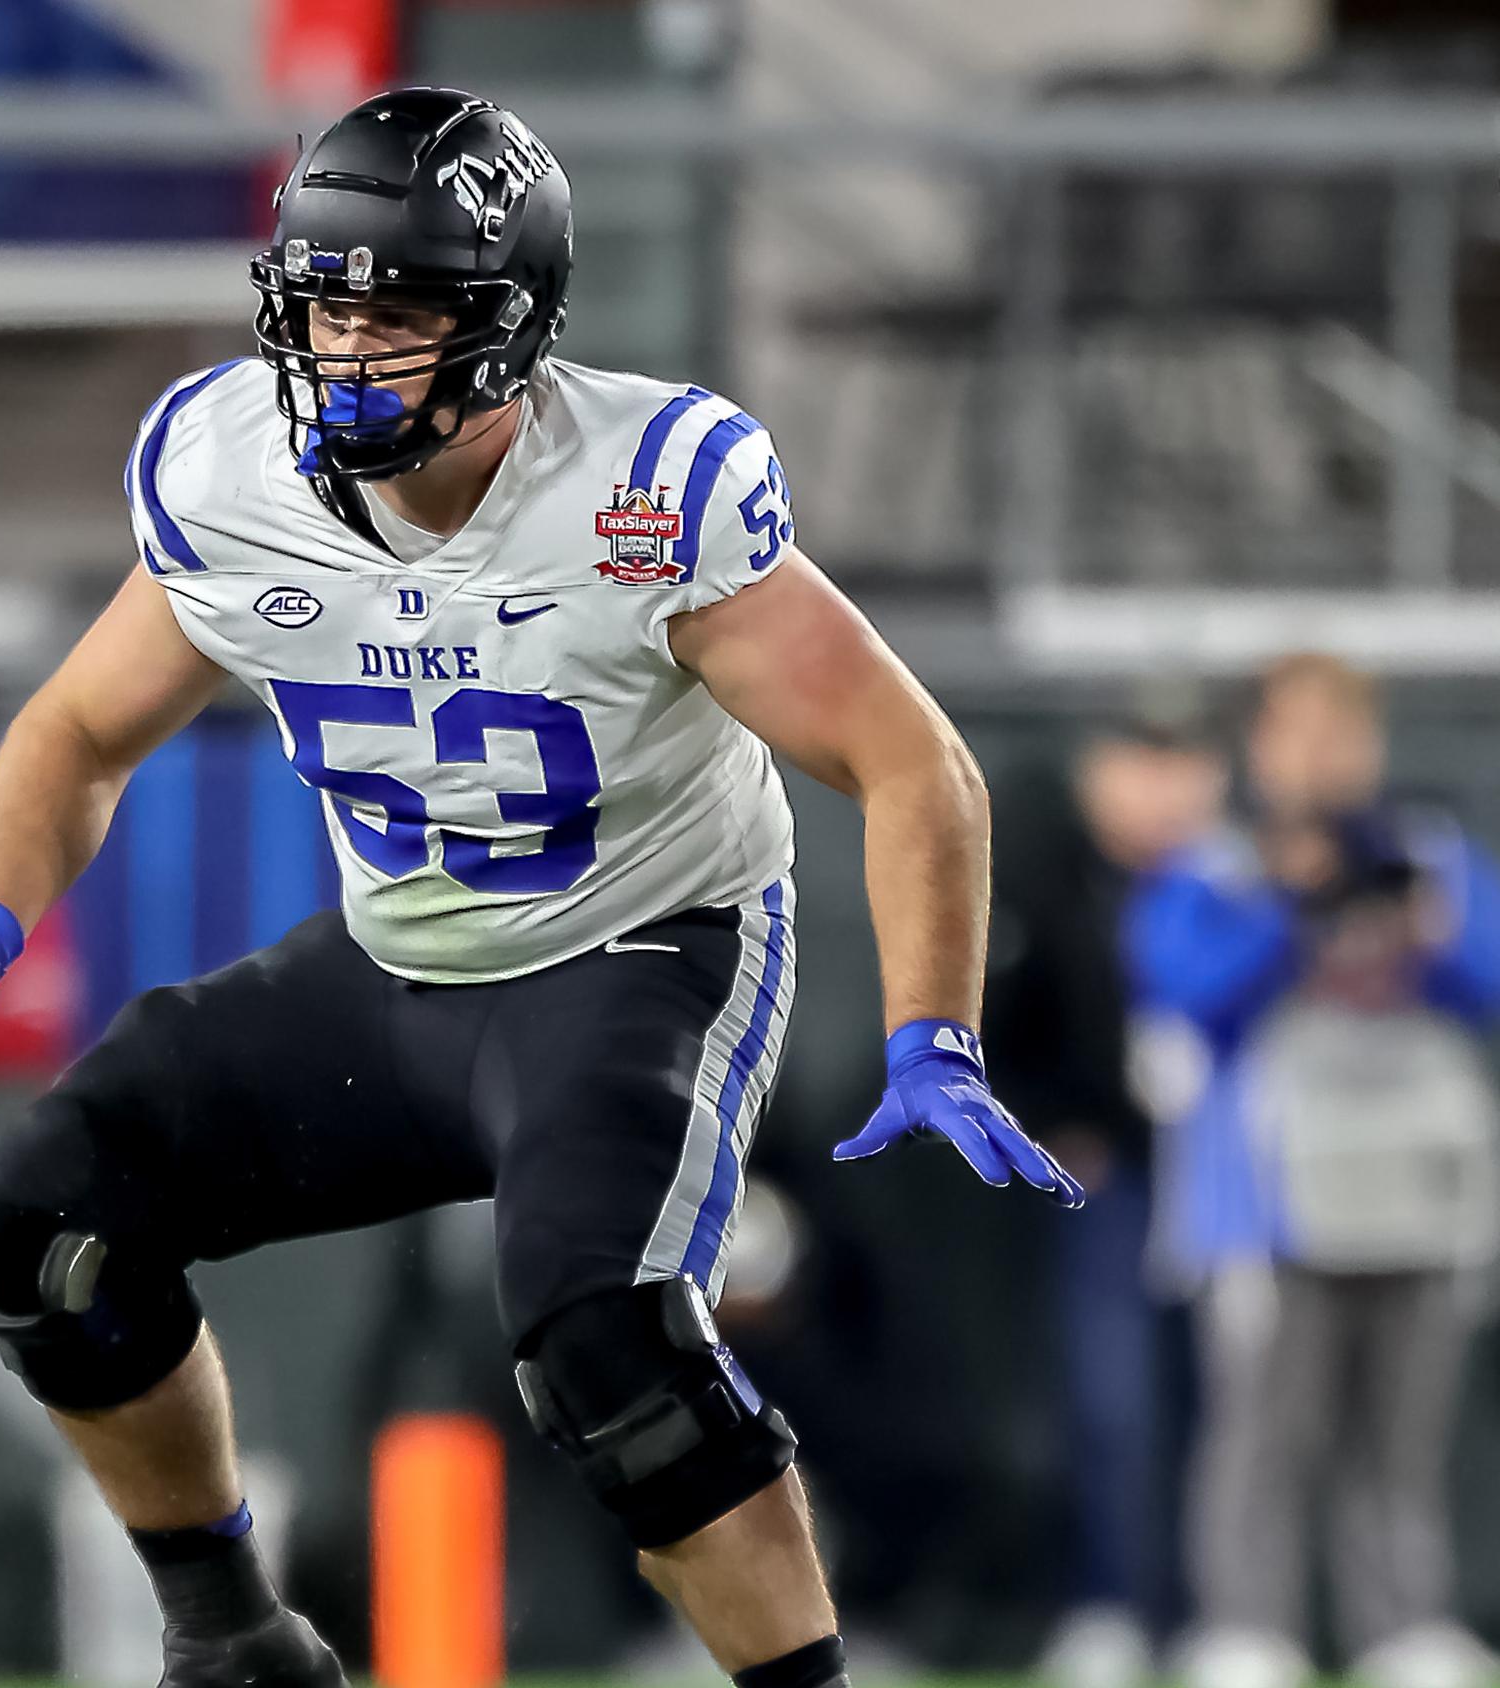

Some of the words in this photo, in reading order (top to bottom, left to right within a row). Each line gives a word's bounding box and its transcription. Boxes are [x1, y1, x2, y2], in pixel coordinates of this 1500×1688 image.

[600, 515, 675, 534] TaxSlayer
[266, 597, 311, 613] ACC
[398, 589, 425, 616] D
[357, 642, 481, 680] DUKE
[267, 678, 603, 894] 53
